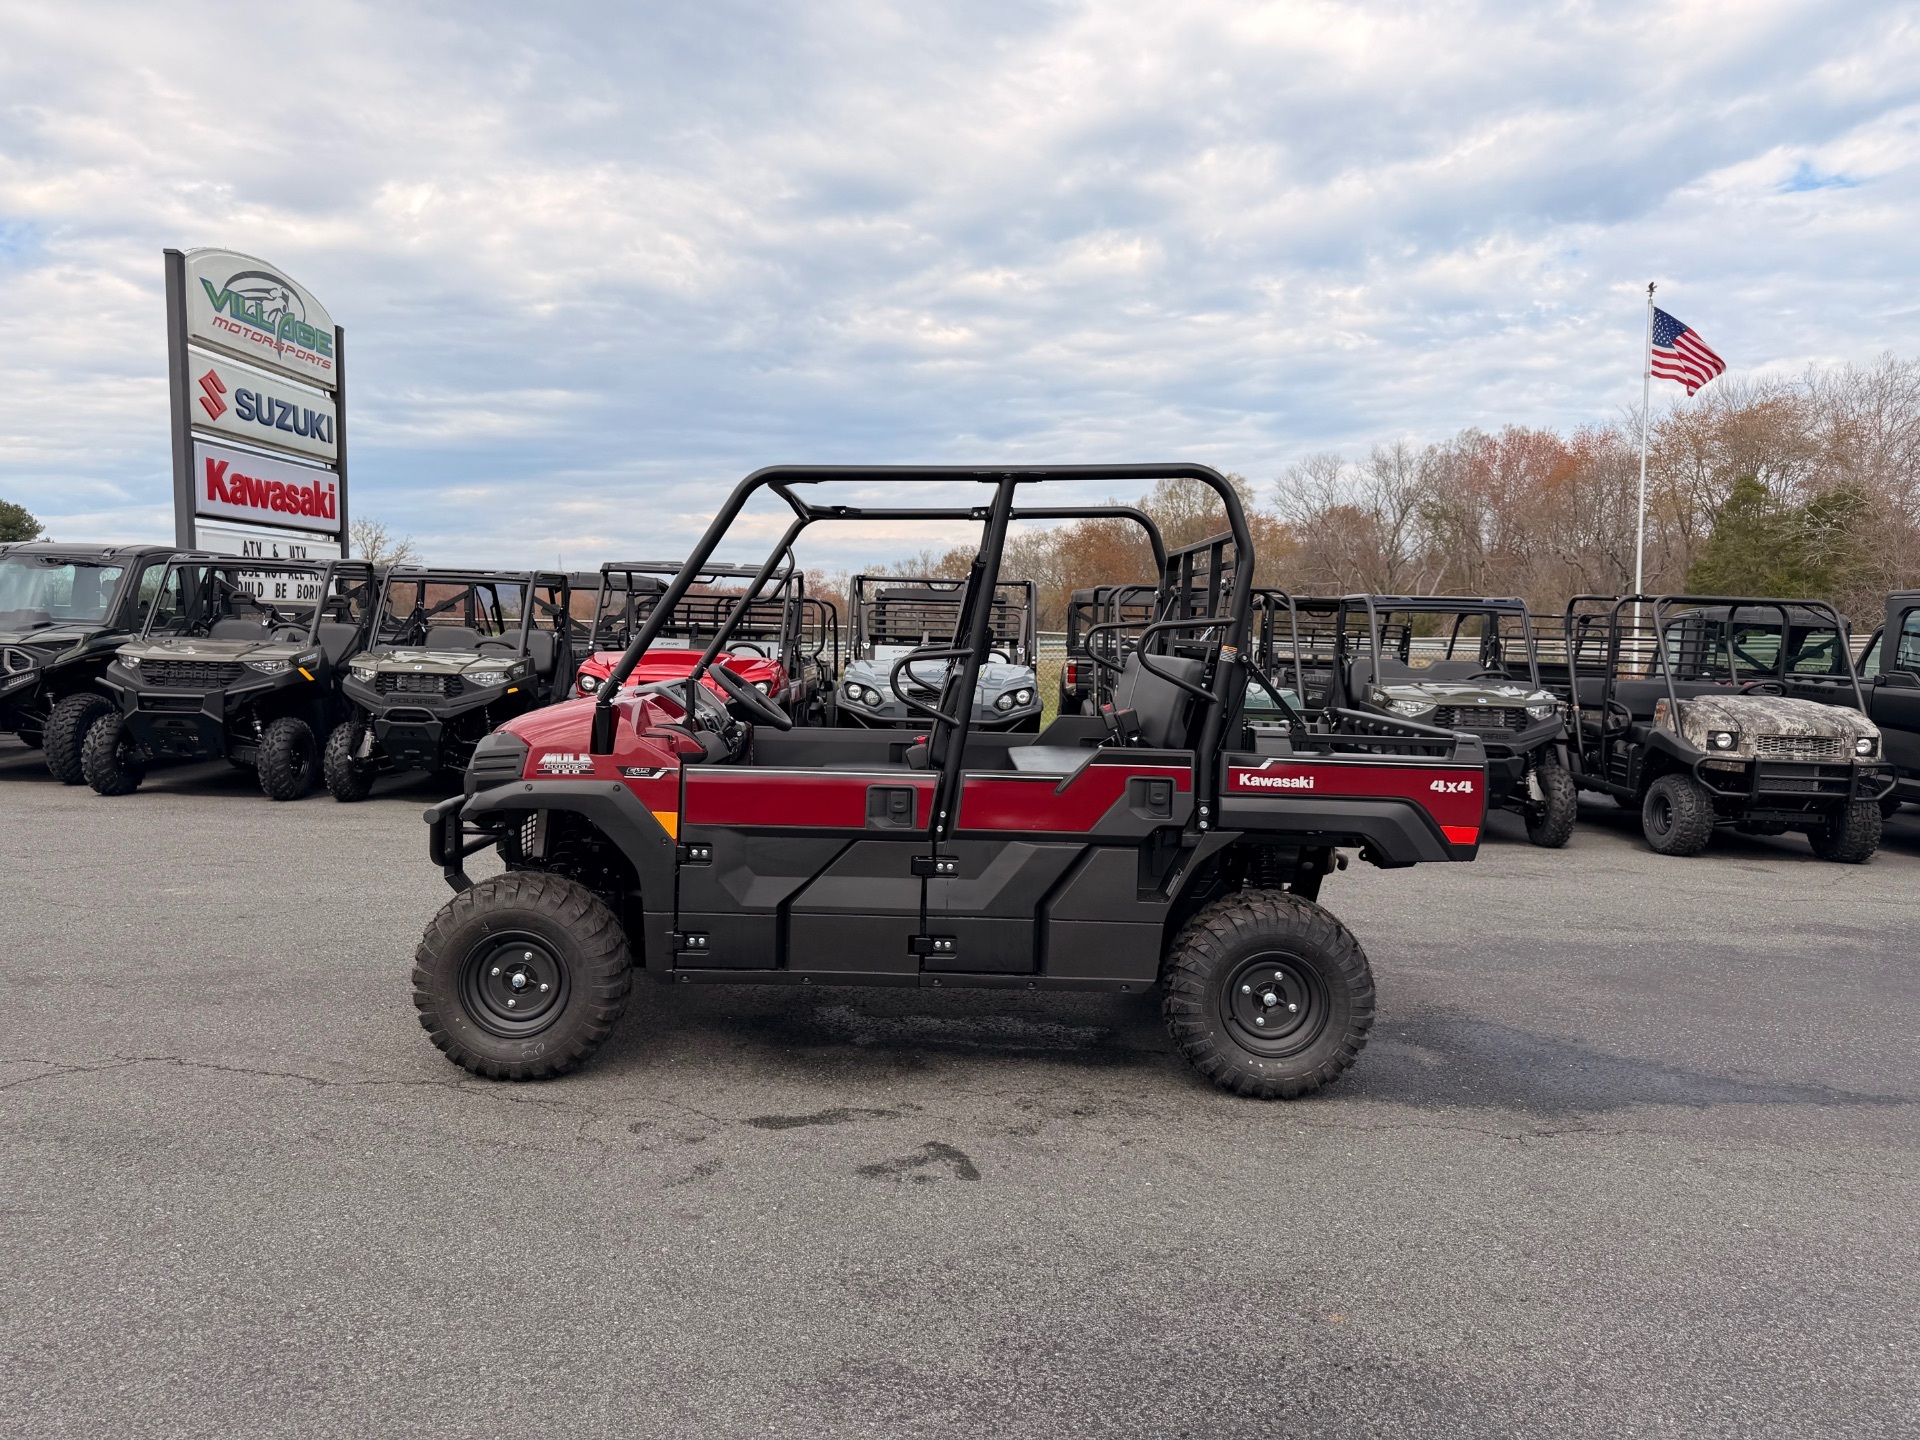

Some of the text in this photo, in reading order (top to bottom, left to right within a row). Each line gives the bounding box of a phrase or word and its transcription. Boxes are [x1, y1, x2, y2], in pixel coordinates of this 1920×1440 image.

[199, 277, 333, 360] VILLAGE
[212, 316, 332, 370] MOTORSPORTS
[235, 387, 333, 444] SUZUKI
[206, 456, 336, 520] Kawasaki
[243, 540, 306, 559] ATV & UTV
[275, 583, 287, 599] BE
[155, 668, 218, 679] POLARIS
[390, 697, 439, 705] POLARIS
[538, 753, 594, 764] MULE
[1239, 773, 1314, 789] Kawasaki
[1430, 780, 1473, 793] 4x4
